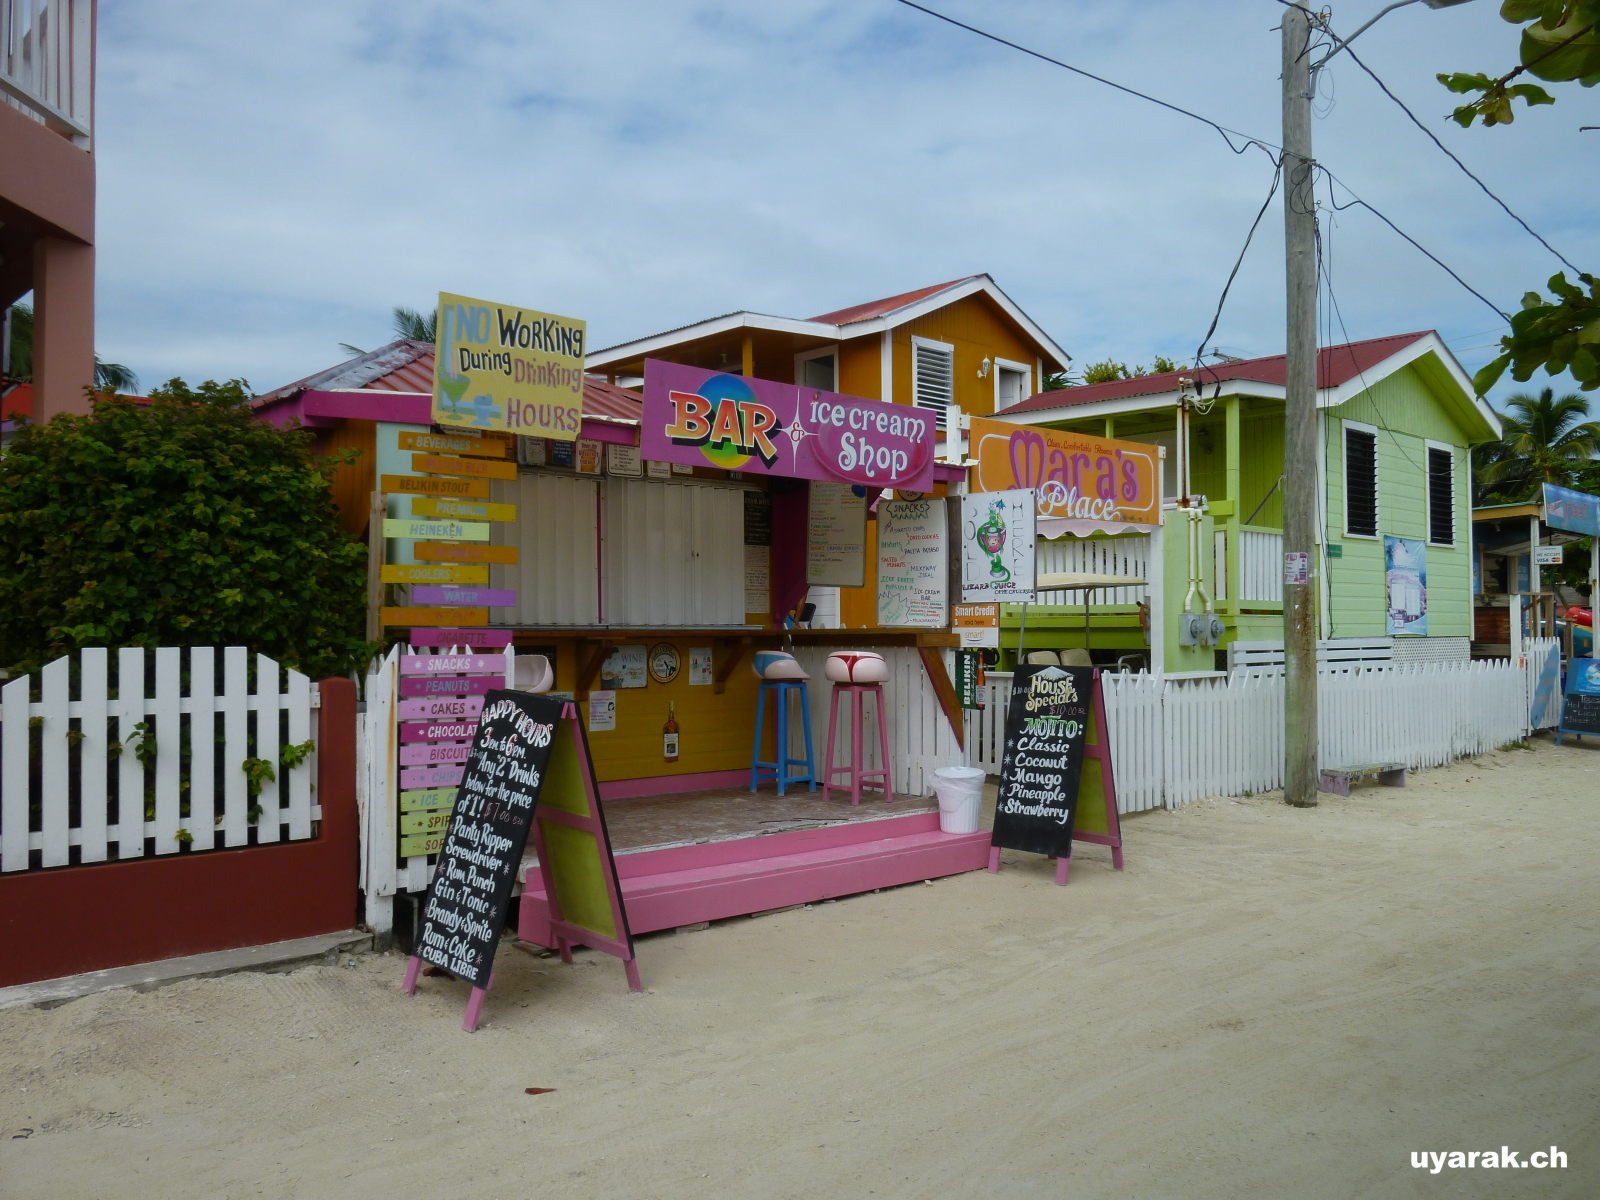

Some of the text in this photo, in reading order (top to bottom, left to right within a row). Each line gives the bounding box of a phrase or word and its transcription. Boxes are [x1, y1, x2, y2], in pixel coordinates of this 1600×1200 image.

[456, 303, 491, 344] NO
[459, 347, 582, 393] During Drinking
[506, 397, 579, 432] HOURS
[665, 390, 779, 464] BAR
[790, 422, 804, 442] &
[809, 397, 926, 444] ice cream
[416, 436, 471, 451] BEVERAGES
[838, 431, 908, 480] Shop
[1008, 430, 1141, 503] Mara's
[400, 479, 471, 493] BELIKIN STOUT
[1037, 480, 1120, 520] Place
[435, 502, 488, 516] PREMIUM
[894, 503, 925, 513] SNACKS
[409, 523, 463, 537] HEINEKEN
[408, 568, 451, 580] COOLERS
[994, 581, 1016, 590] JUICE
[443, 591, 479, 603] WATER
[955, 606, 974, 617] Smart
[974, 605, 996, 617] Credit
[427, 658, 471, 671] SNACKS
[963, 654, 971, 705] BELIKIN
[425, 680, 470, 692] PEANUTS
[431, 702, 465, 715] CAKES
[481, 699, 523, 727] HAPPY
[515, 711, 554, 748] HOURS
[1015, 752, 1068, 769] Coconut
[1017, 737, 1070, 753] Classic
[477, 751, 497, 779] Any
[508, 760, 540, 788] Drinks
[1009, 768, 1062, 789] Mango
[420, 793, 439, 806] ICE
[457, 796, 471, 814] of
[464, 771, 486, 793] below
[485, 779, 498, 798] for
[497, 782, 511, 802] the
[507, 787, 533, 811] price
[1007, 783, 1066, 804] Pineapple
[1004, 798, 1069, 825] Strawberry
[453, 815, 513, 855] Panty Ripper
[445, 835, 503, 871] Screwdriver
[446, 857, 496, 893] Rum Punch
[435, 877, 455, 901] Gin
[461, 886, 489, 914] Tonic
[427, 897, 462, 933] Brandy
[463, 912, 492, 943] Sprite
[422, 921, 445, 950] Rum
[448, 935, 476, 963] Coke
[422, 945, 479, 981] CUBA LIBRE
